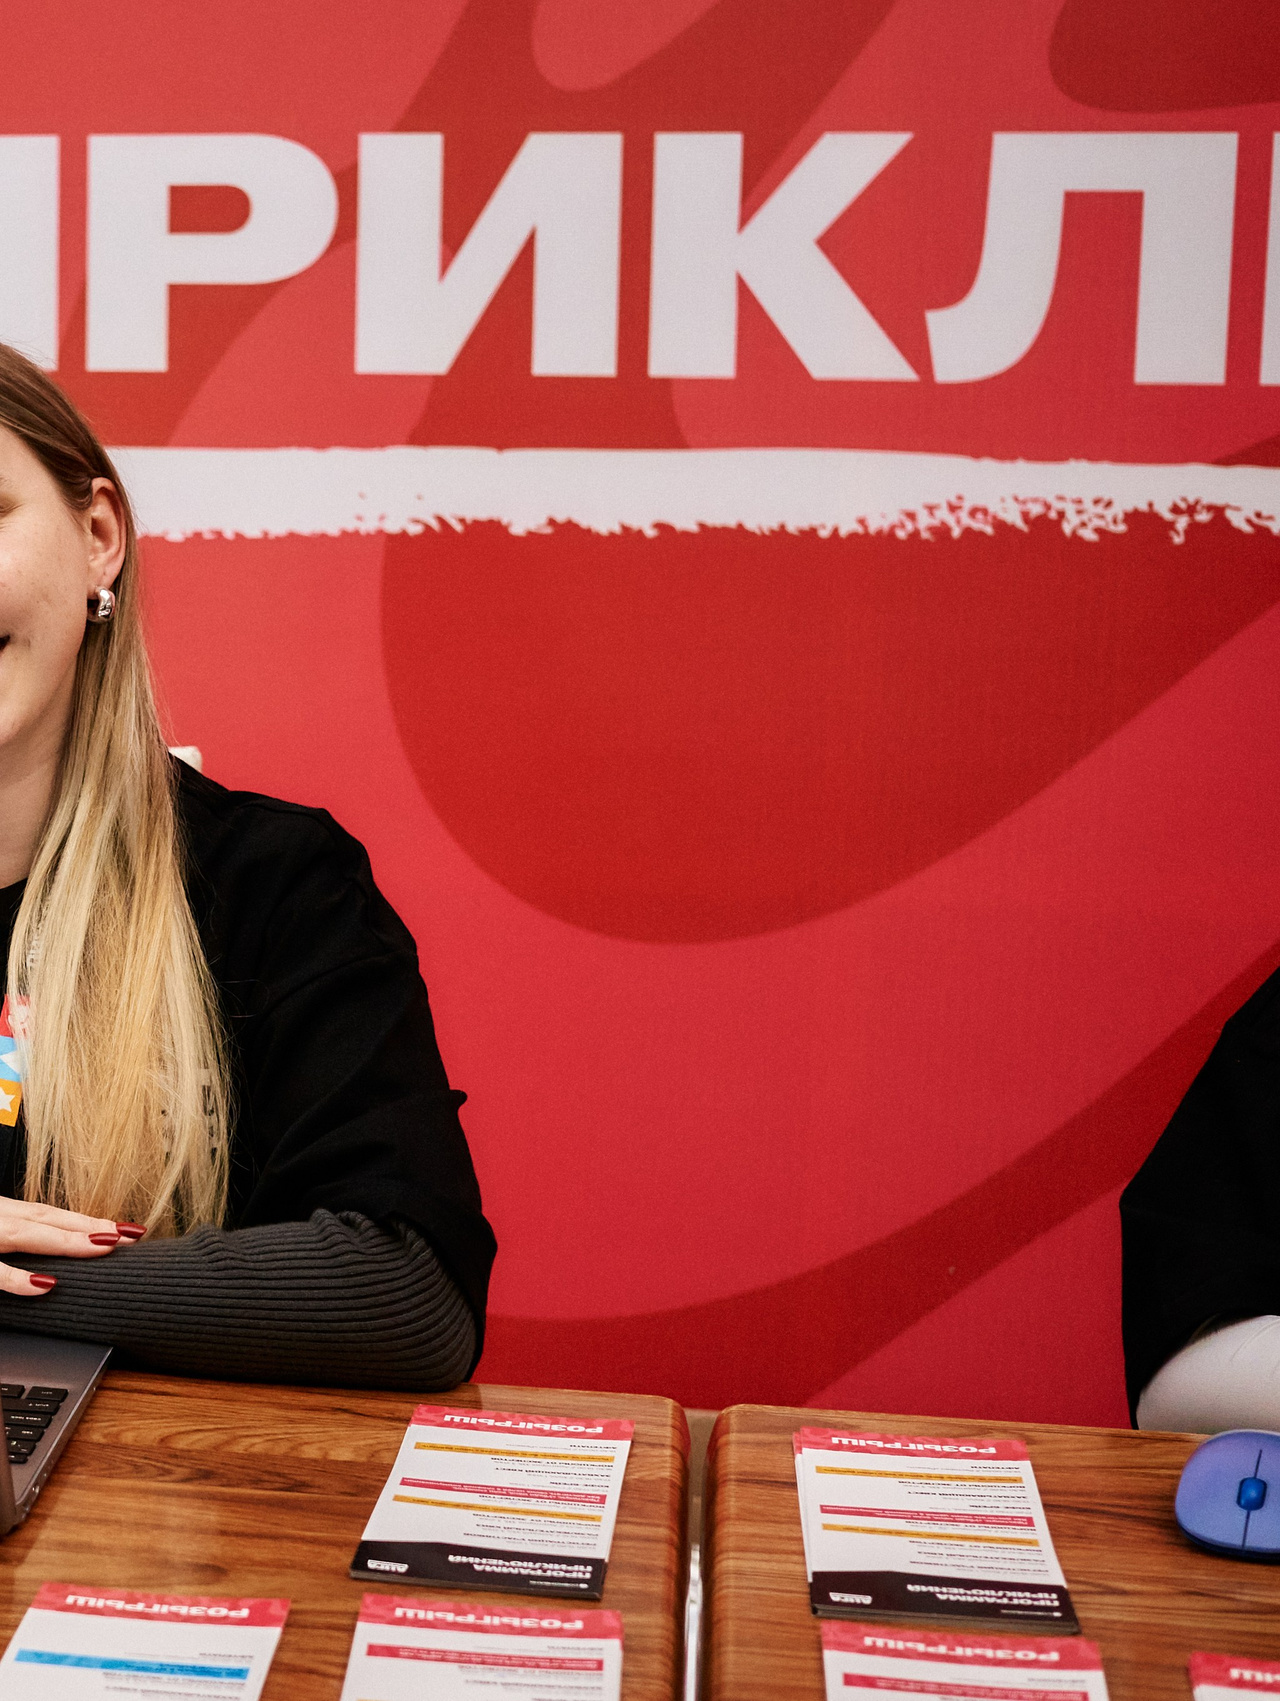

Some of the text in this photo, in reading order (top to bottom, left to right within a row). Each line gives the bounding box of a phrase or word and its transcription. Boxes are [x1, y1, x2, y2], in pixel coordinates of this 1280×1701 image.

[444, 1414, 603, 1433] РОЗЫГРЫШ
[831, 1436, 997, 1454] РОЗЫГРЫШ
[448, 1554, 593, 1571] ПРИКЛЮЧЕНИЙ
[472, 1563, 591, 1579] ПРОГРАММА
[906, 1584, 1058, 1599] ПРИКЛЮЧЕНИЙ
[935, 1593, 1059, 1607] ПРОГРАММА
[65, 1595, 250, 1619] РОЗЫГРЫШ
[394, 1607, 584, 1630] РОЗЫГРЫШ
[863, 1636, 1060, 1663] РОЗЫГРЫШ
